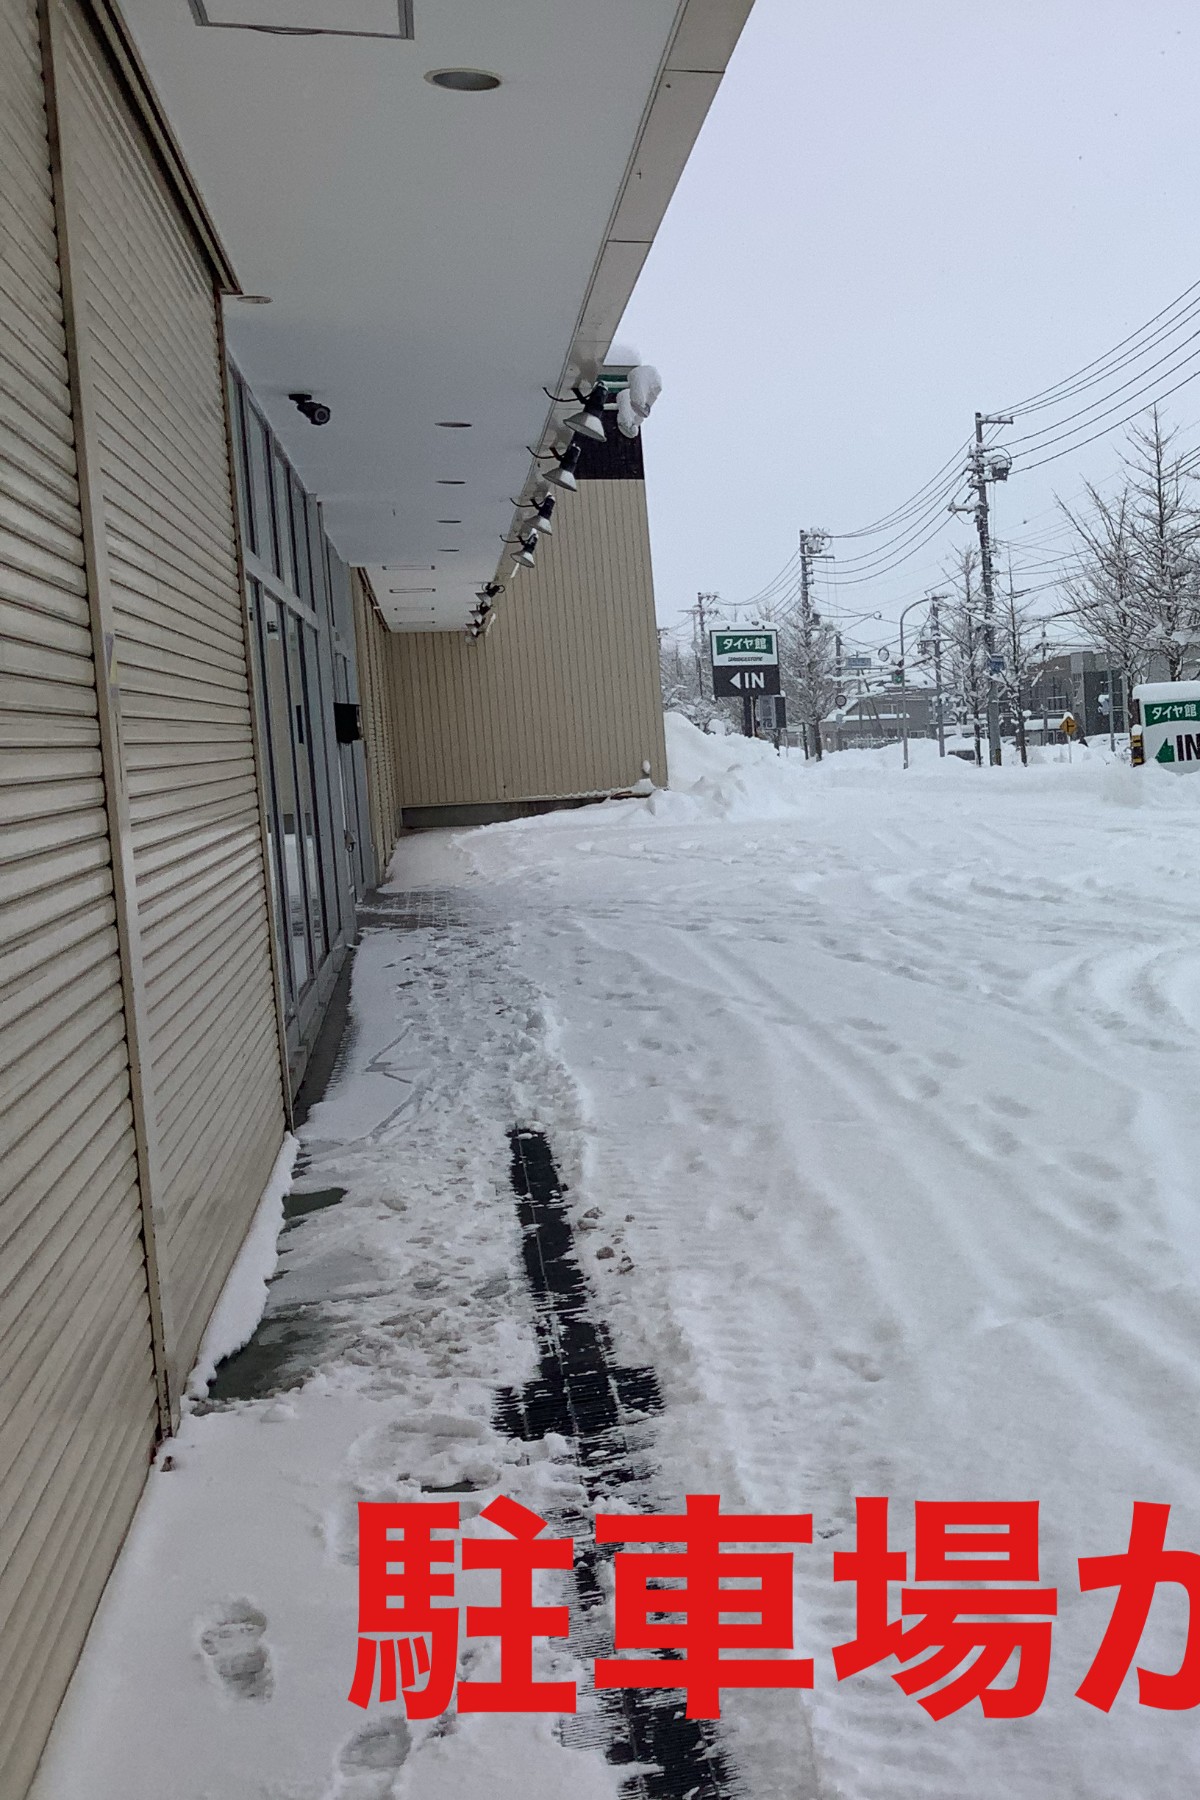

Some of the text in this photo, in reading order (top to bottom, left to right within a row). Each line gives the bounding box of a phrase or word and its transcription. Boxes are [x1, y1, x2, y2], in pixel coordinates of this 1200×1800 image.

[723, 637, 767, 650] タイヤ館
[744, 671, 765, 689] IN
[1151, 703, 1197, 720] タイヤ館
